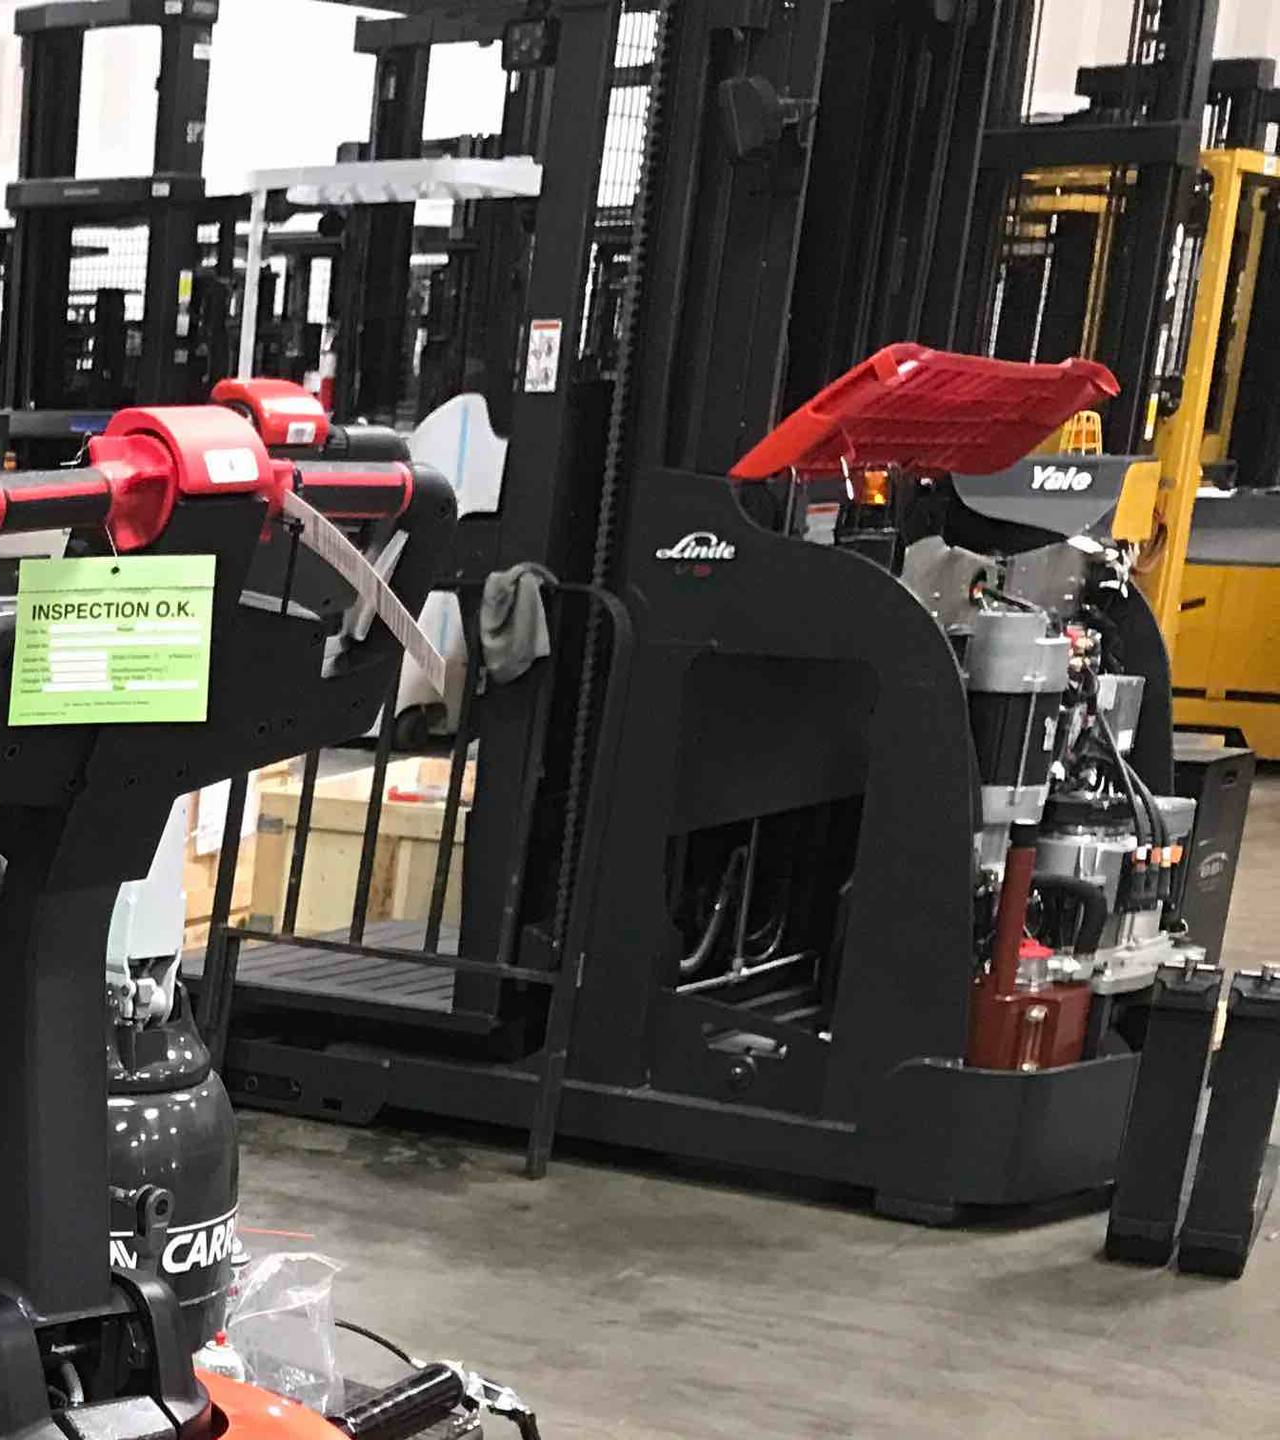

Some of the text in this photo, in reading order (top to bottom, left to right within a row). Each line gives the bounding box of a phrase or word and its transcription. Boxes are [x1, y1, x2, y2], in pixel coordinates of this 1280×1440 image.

[1031, 465, 1093, 491] Yale
[655, 531, 735, 559] Linde
[31, 600, 196, 620] INSPECTION O.K.
